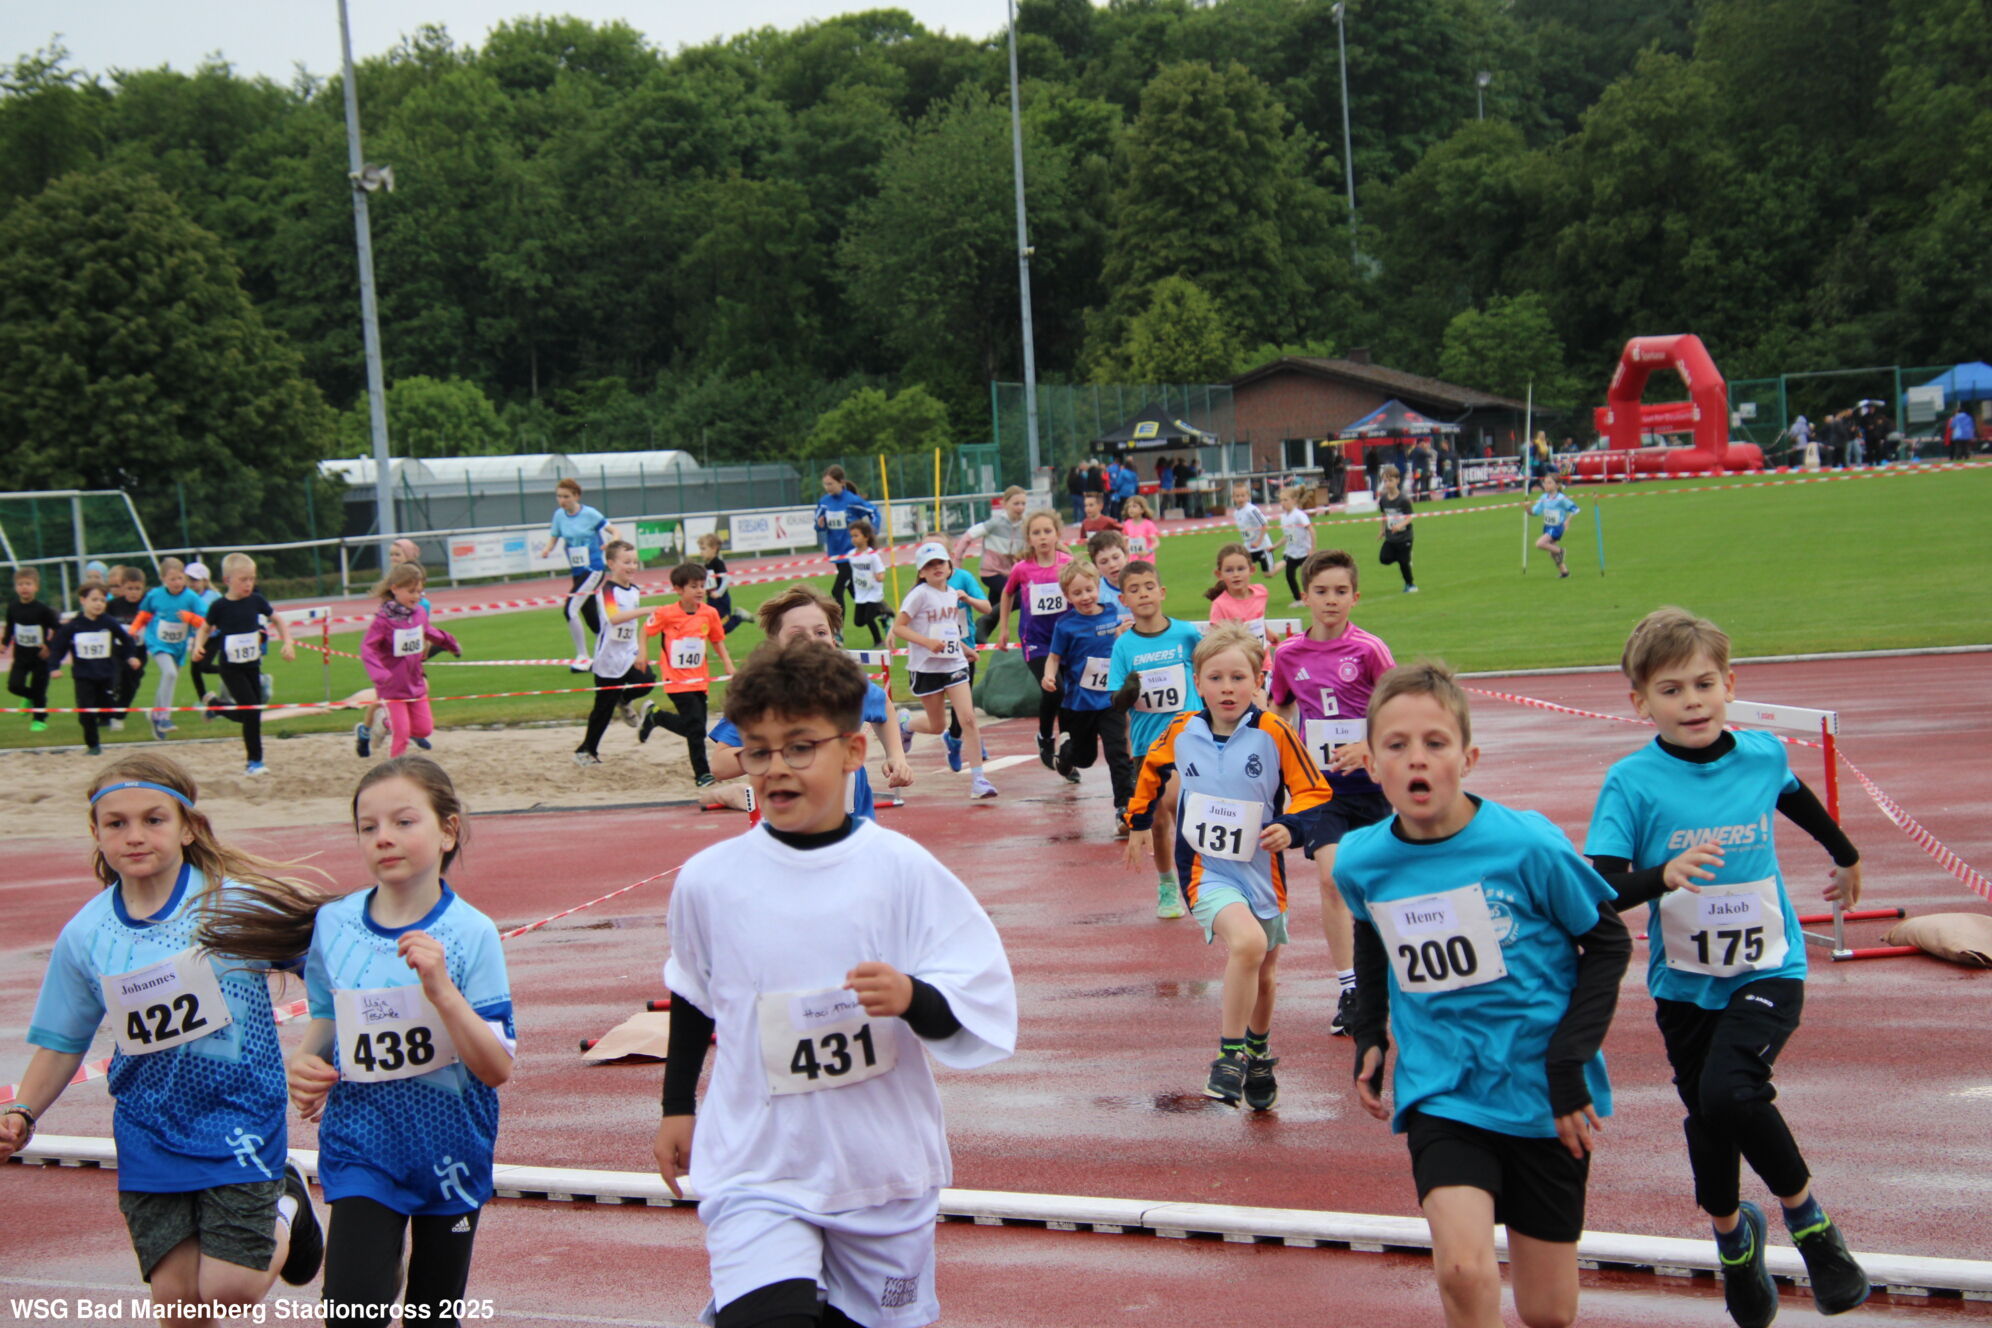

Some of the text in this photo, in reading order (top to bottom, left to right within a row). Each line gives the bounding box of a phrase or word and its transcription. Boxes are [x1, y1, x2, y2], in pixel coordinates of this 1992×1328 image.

[1038, 596, 1063, 612] 428
[83, 645, 105, 656] 197
[234, 645, 257, 660] 187
[940, 640, 960, 655] 54
[678, 652, 701, 666] 140
[1091, 672, 1108, 687] 14
[1141, 687, 1179, 709] 179
[1320, 688, 1340, 717] 6
[1208, 805, 1237, 818] Julius
[1195, 822, 1243, 855] 131
[1404, 910, 1446, 926] Henry
[1707, 901, 1750, 916] Jakob
[1690, 926, 1764, 967] 175
[1398, 935, 1479, 984] 200
[120, 971, 176, 997] Johannes
[126, 993, 208, 1045] 422
[353, 1026, 435, 1073] 438
[790, 1023, 877, 1081] 431
